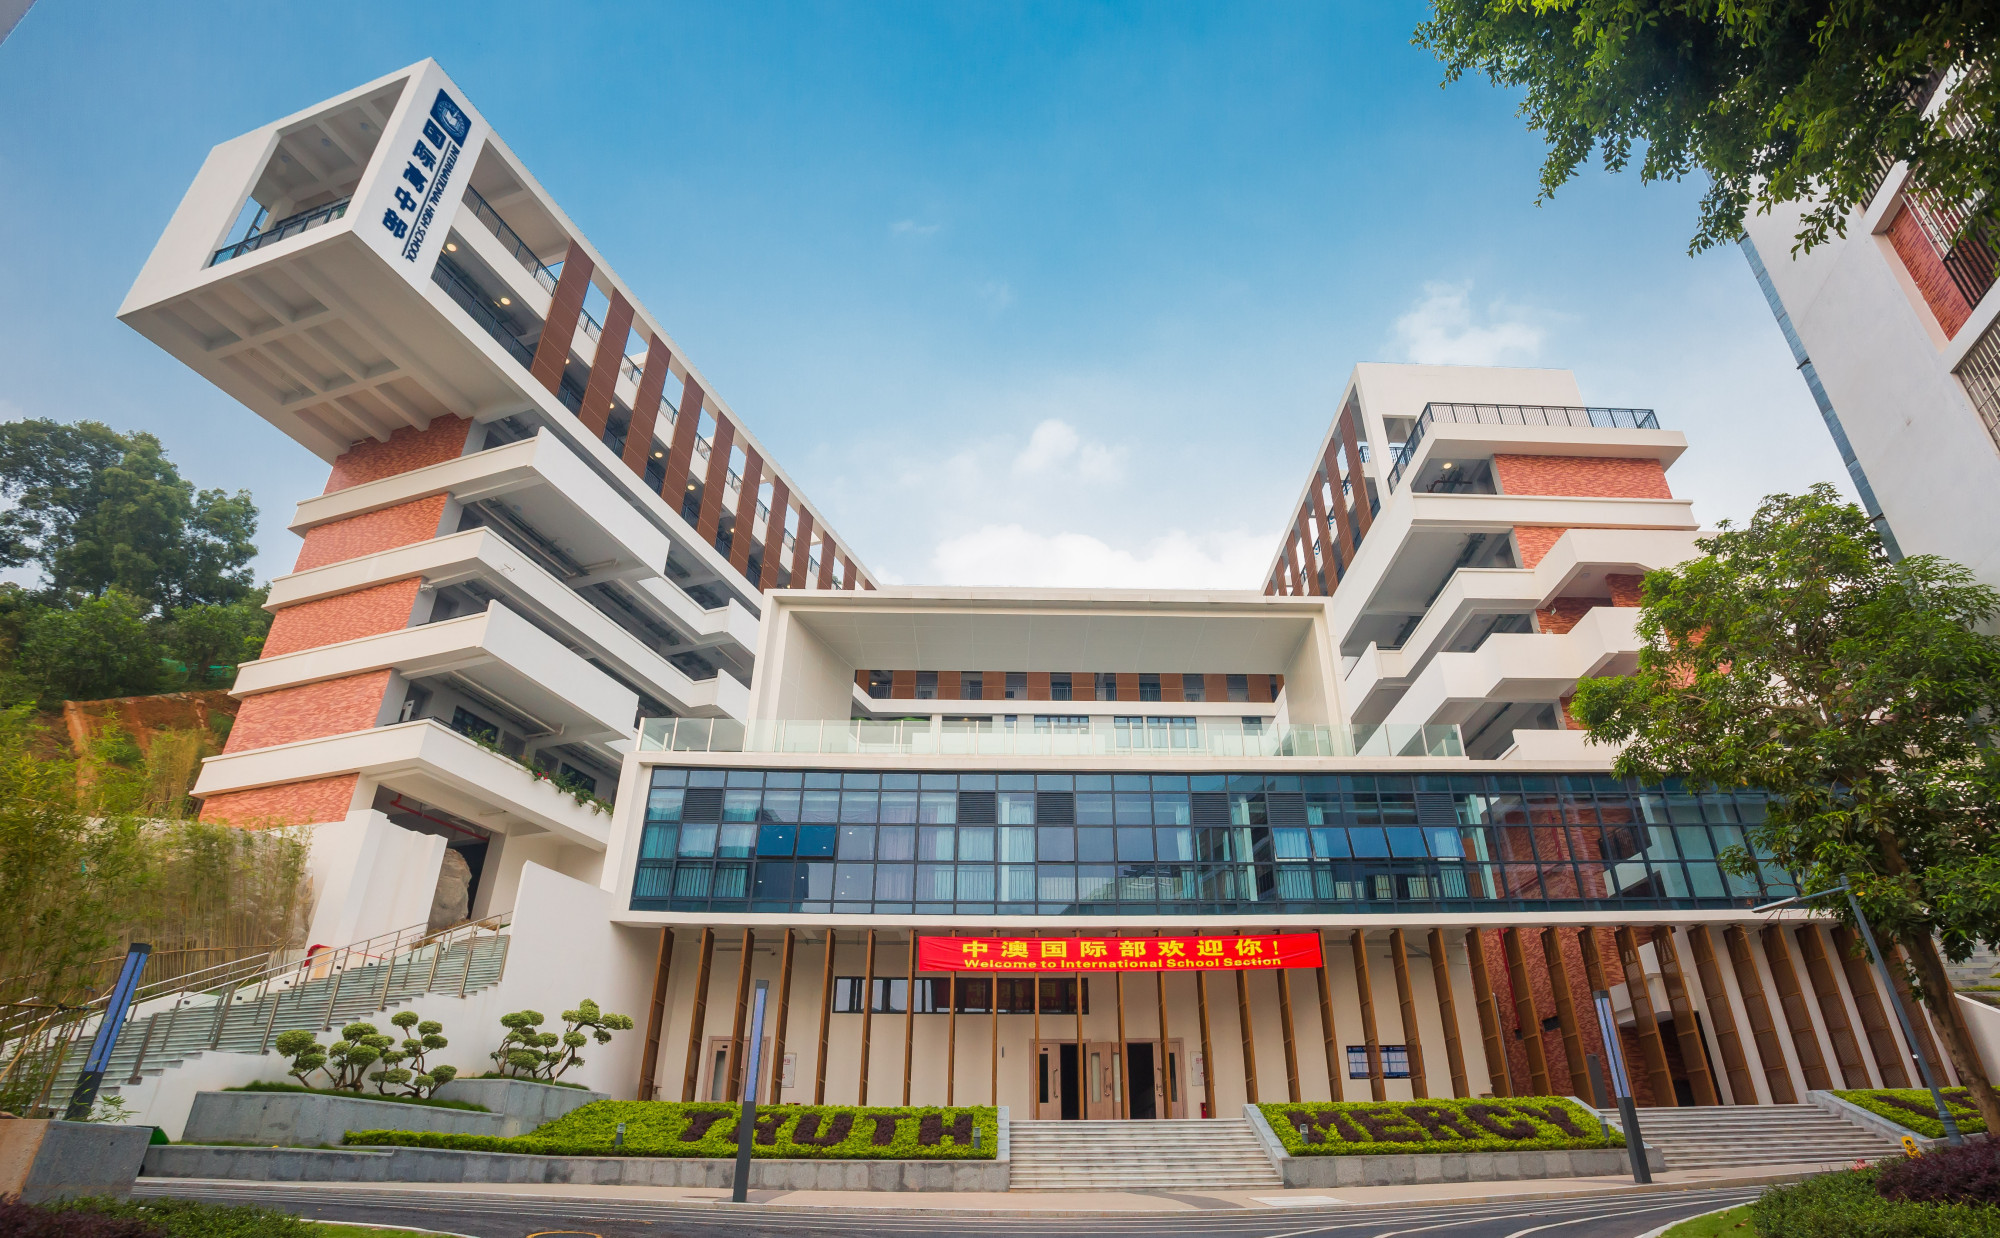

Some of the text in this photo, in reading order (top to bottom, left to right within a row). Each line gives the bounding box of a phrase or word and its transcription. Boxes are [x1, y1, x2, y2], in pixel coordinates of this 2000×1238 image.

[382, 118, 447, 240] 国际高中部
[429, 143, 461, 207] INTERNATIONAL
[419, 203, 436, 231] HIGH
[405, 225, 427, 263] SCHOOL
[964, 957, 1282, 969] Welcome to International School Section
[681, 1110, 974, 1147] TRUTH
[1286, 1103, 1587, 1145] MERCY
